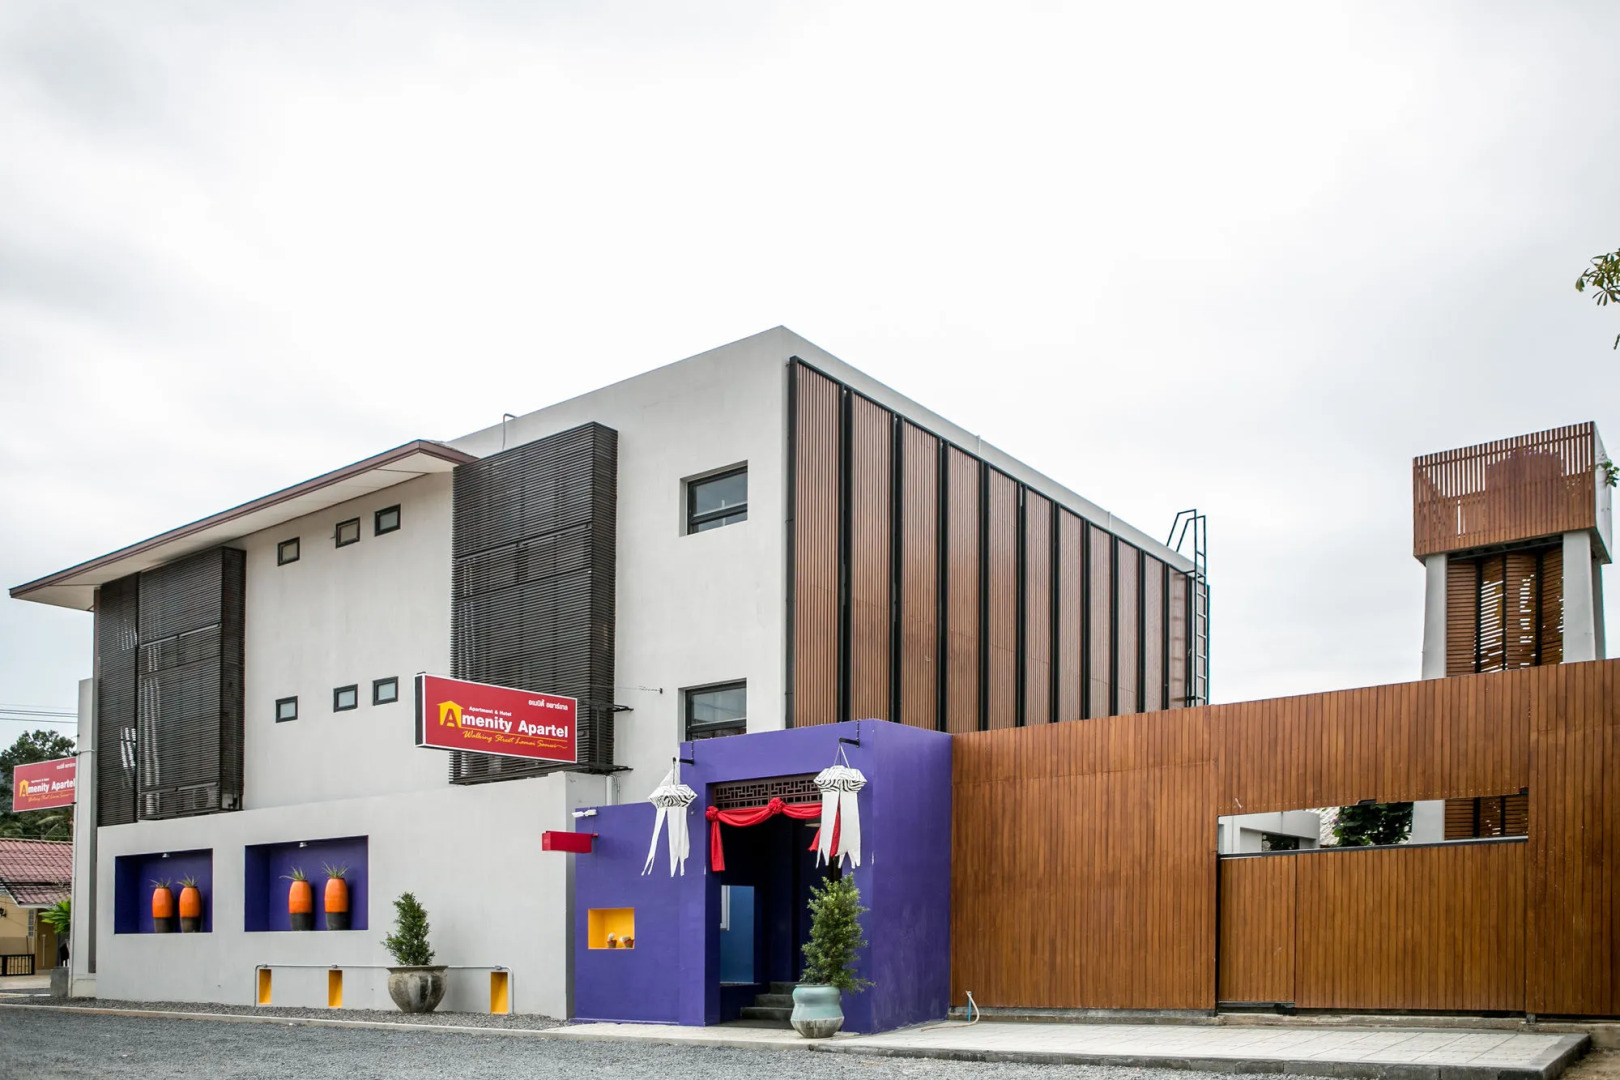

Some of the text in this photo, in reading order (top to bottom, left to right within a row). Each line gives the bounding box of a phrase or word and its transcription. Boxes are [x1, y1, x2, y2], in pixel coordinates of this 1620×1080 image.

[469, 706, 493, 714] Apartment
[438, 702, 568, 737] Amenity Apartel
[463, 730, 492, 743] Walking
[495, 734, 514, 744] Street
[51, 778, 76, 791] Apartel
